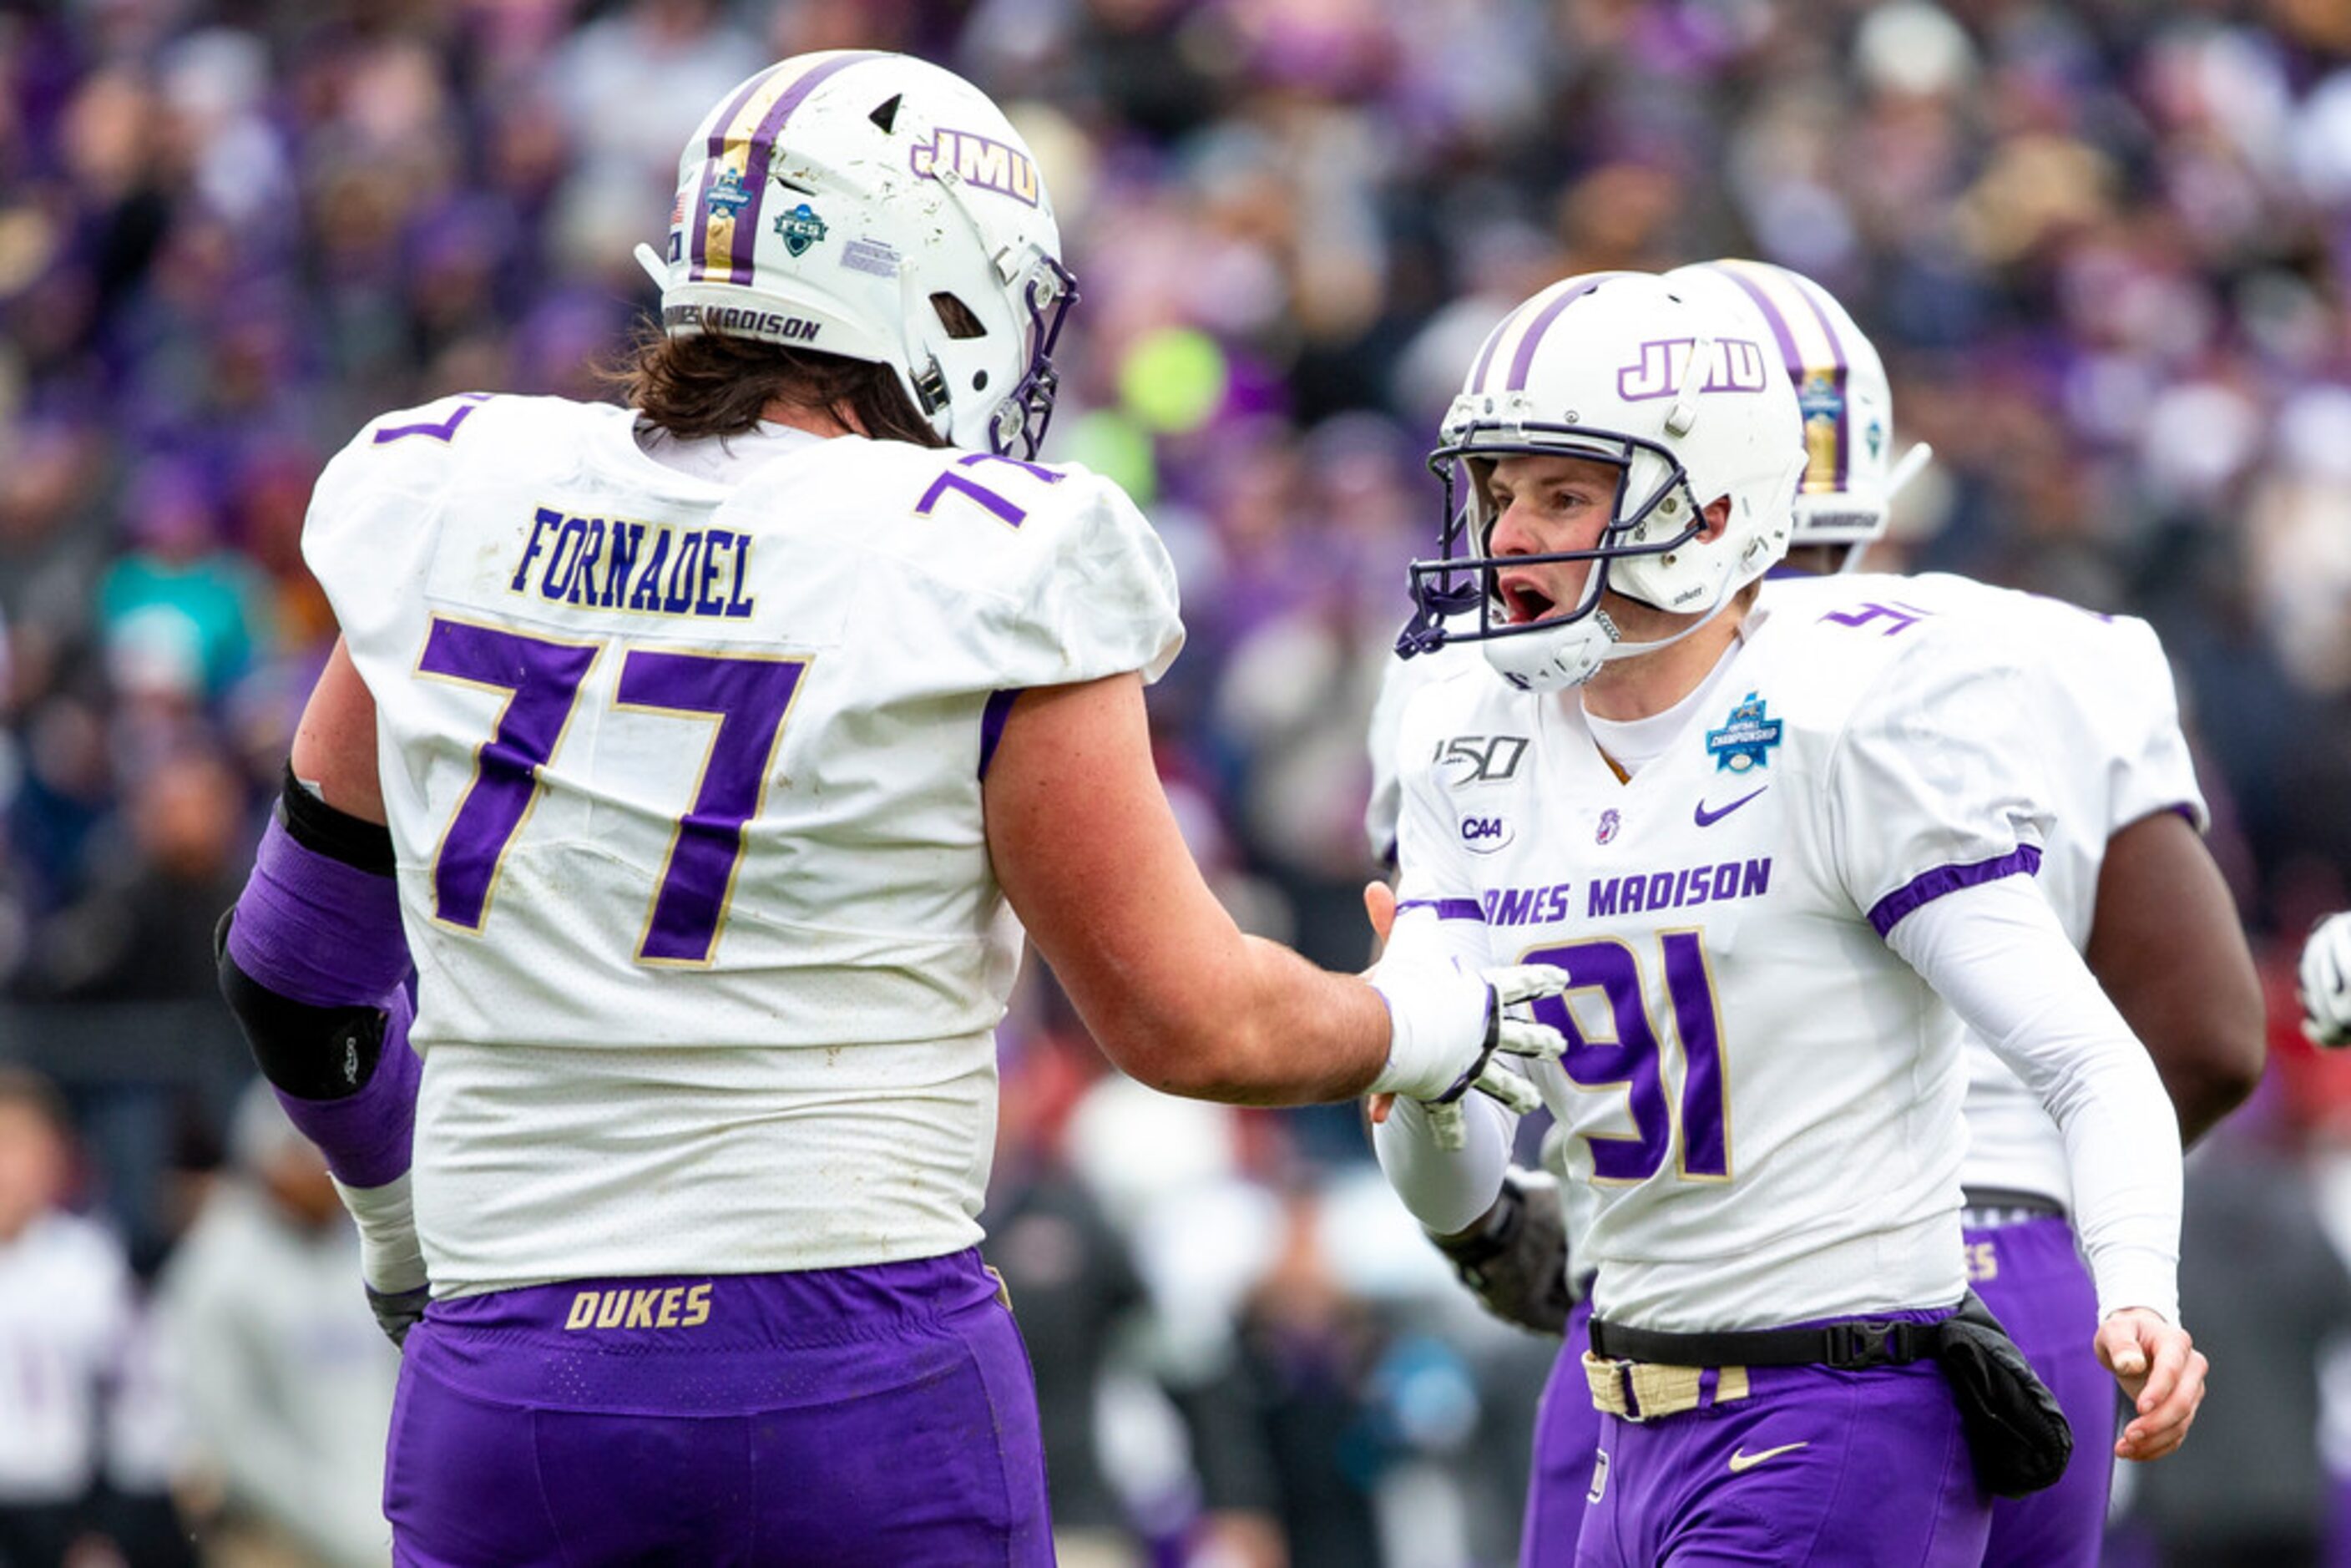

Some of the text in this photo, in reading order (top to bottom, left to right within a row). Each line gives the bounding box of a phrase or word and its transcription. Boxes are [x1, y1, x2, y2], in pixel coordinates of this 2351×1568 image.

[910, 128, 1039, 209] JMU
[1616, 337, 1767, 402] JMU
[508, 504, 757, 620] FORNADEL
[414, 611, 817, 968] 77
[1462, 817, 1502, 839] CAA
[1484, 857, 1772, 926] AMES MADISON
[1515, 926, 1733, 1186] 91
[564, 1282, 713, 1330] DUKES
